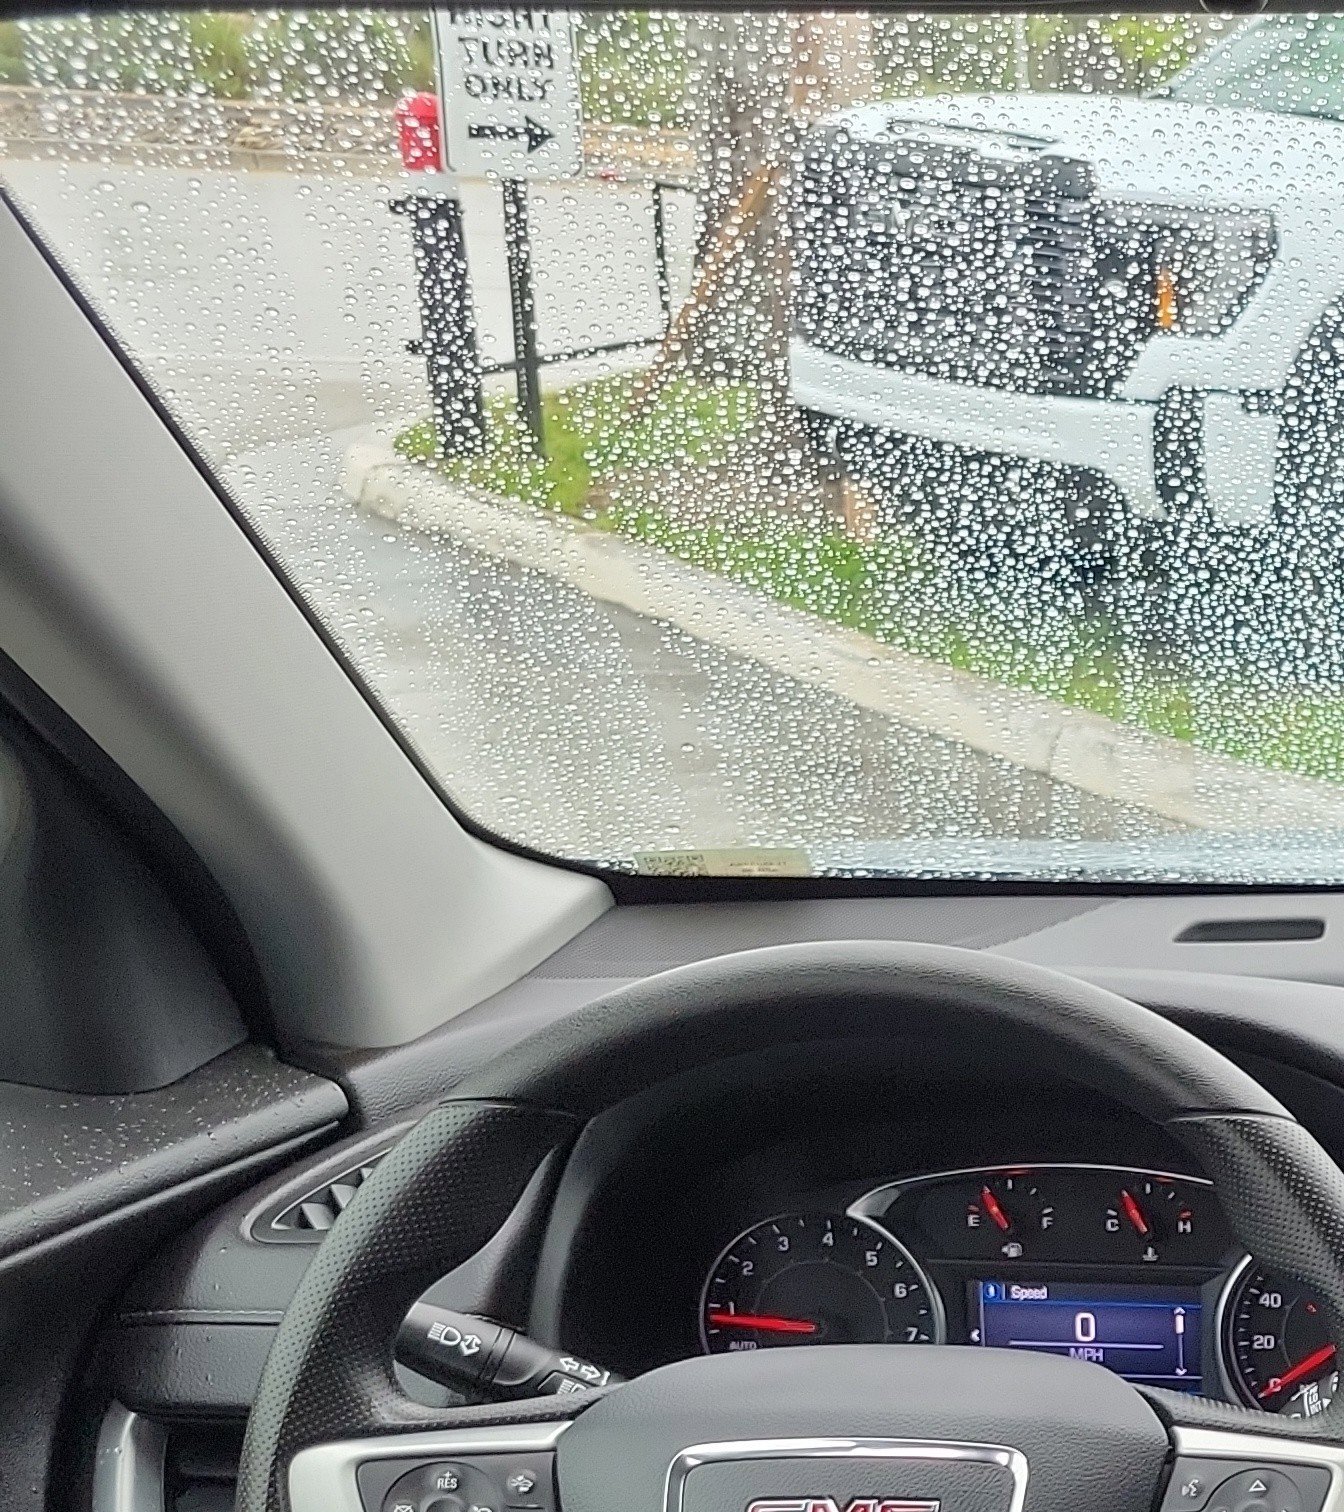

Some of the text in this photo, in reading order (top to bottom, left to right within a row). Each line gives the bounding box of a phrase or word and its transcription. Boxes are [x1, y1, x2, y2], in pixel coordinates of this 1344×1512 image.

[458, 36, 554, 69] TURN
[465, 74, 553, 101] ONLY
[967, 1214, 981, 1228] E
[1041, 1216, 1054, 1230] F
[1105, 1218, 1120, 1232] C
[1177, 1220, 1192, 1234] H
[777, 1235, 790, 1251] 3
[822, 1232, 834, 1247] 4
[865, 1250, 878, 1267] 5
[741, 1260, 754, 1276] 2
[893, 1282, 908, 1299] 6
[1010, 1285, 1048, 1301] Speed
[1258, 1292, 1282, 1309] 40
[905, 1326, 919, 1343] 7
[1074, 1311, 1097, 1343] 0
[729, 1340, 757, 1351] AUTO
[1252, 1334, 1276, 1351] 20
[1068, 1347, 1105, 1362] MPH
[436, 1476, 458, 1490] RES
